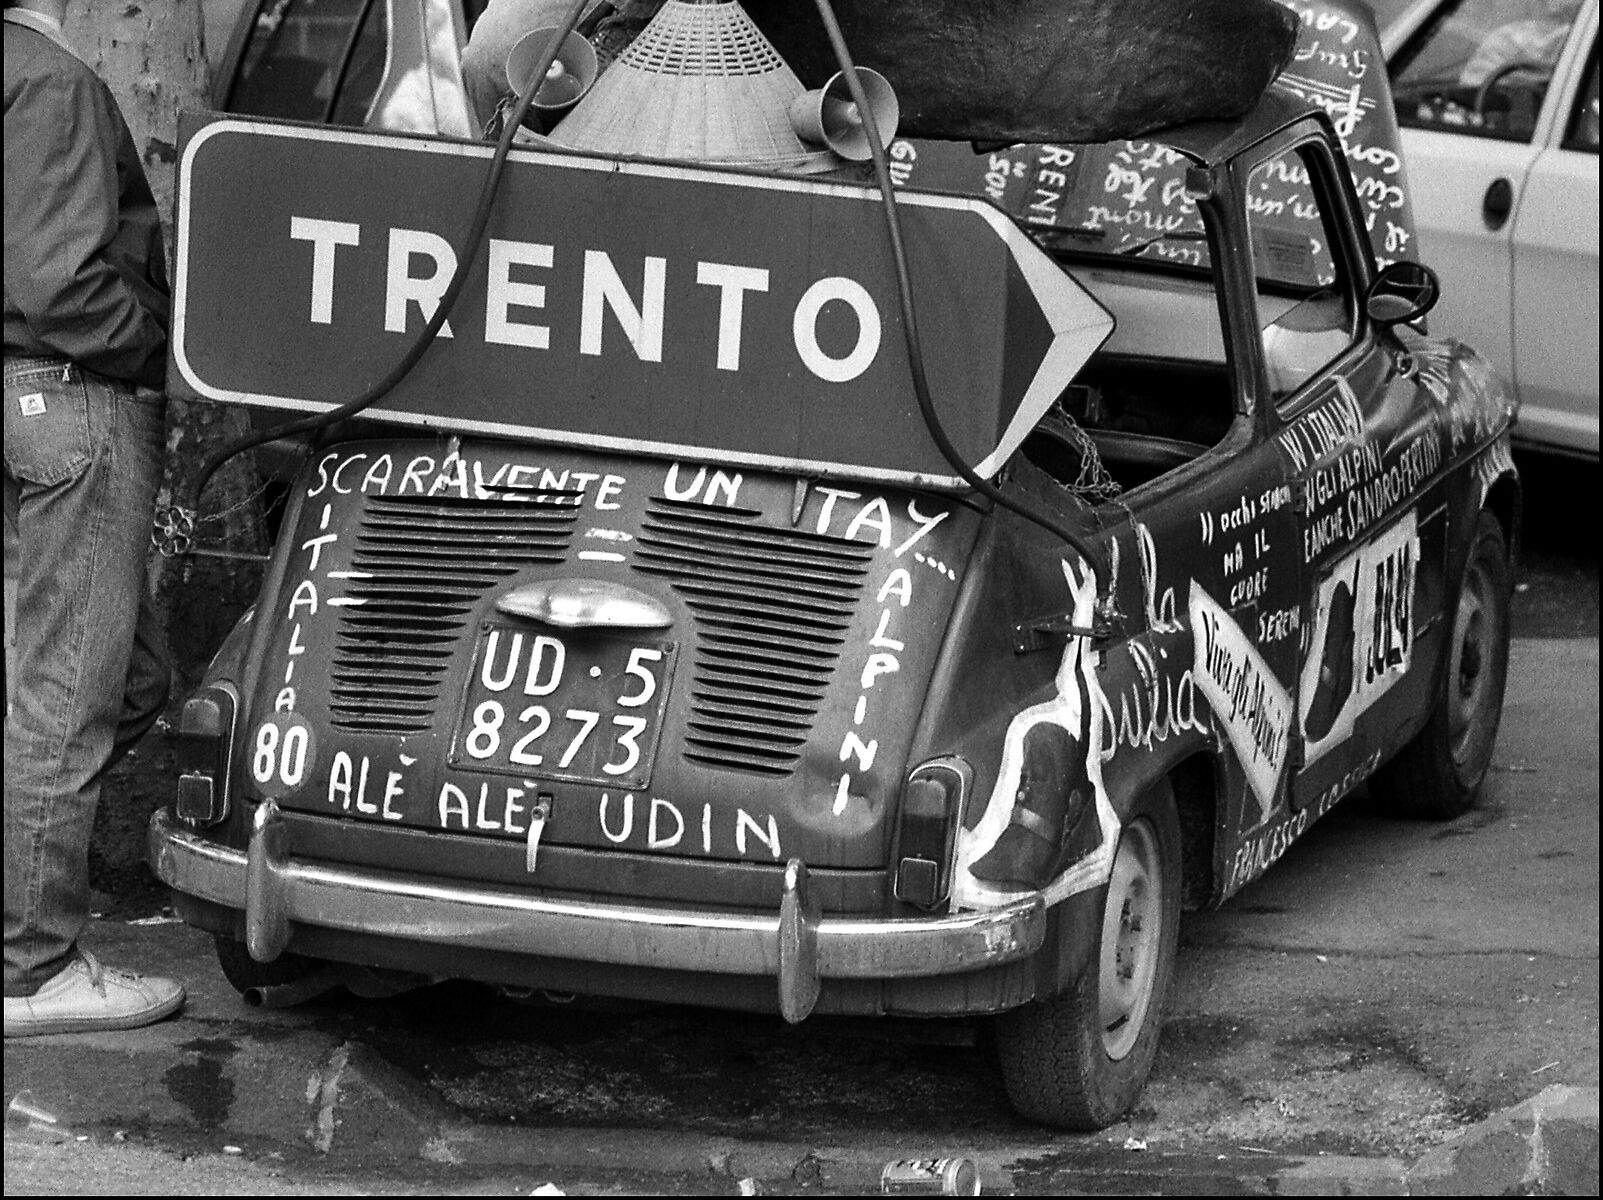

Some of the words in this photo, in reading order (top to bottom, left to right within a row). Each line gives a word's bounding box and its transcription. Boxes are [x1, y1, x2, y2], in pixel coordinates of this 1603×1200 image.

[290, 216, 882, 383] TRENTO
[307, 450, 627, 511] SCARAVENTE
[663, 461, 744, 507] UN
[1337, 438, 1384, 494] ALPINI
[273, 503, 338, 712] ITALIA
[1137, 522, 1184, 634] la
[1230, 566, 1269, 607] CUORE
[831, 567, 914, 817] ALPINI
[252, 722, 309, 786] 80
[464, 700, 648, 777] 8273
[598, 790, 782, 858] UDIN
